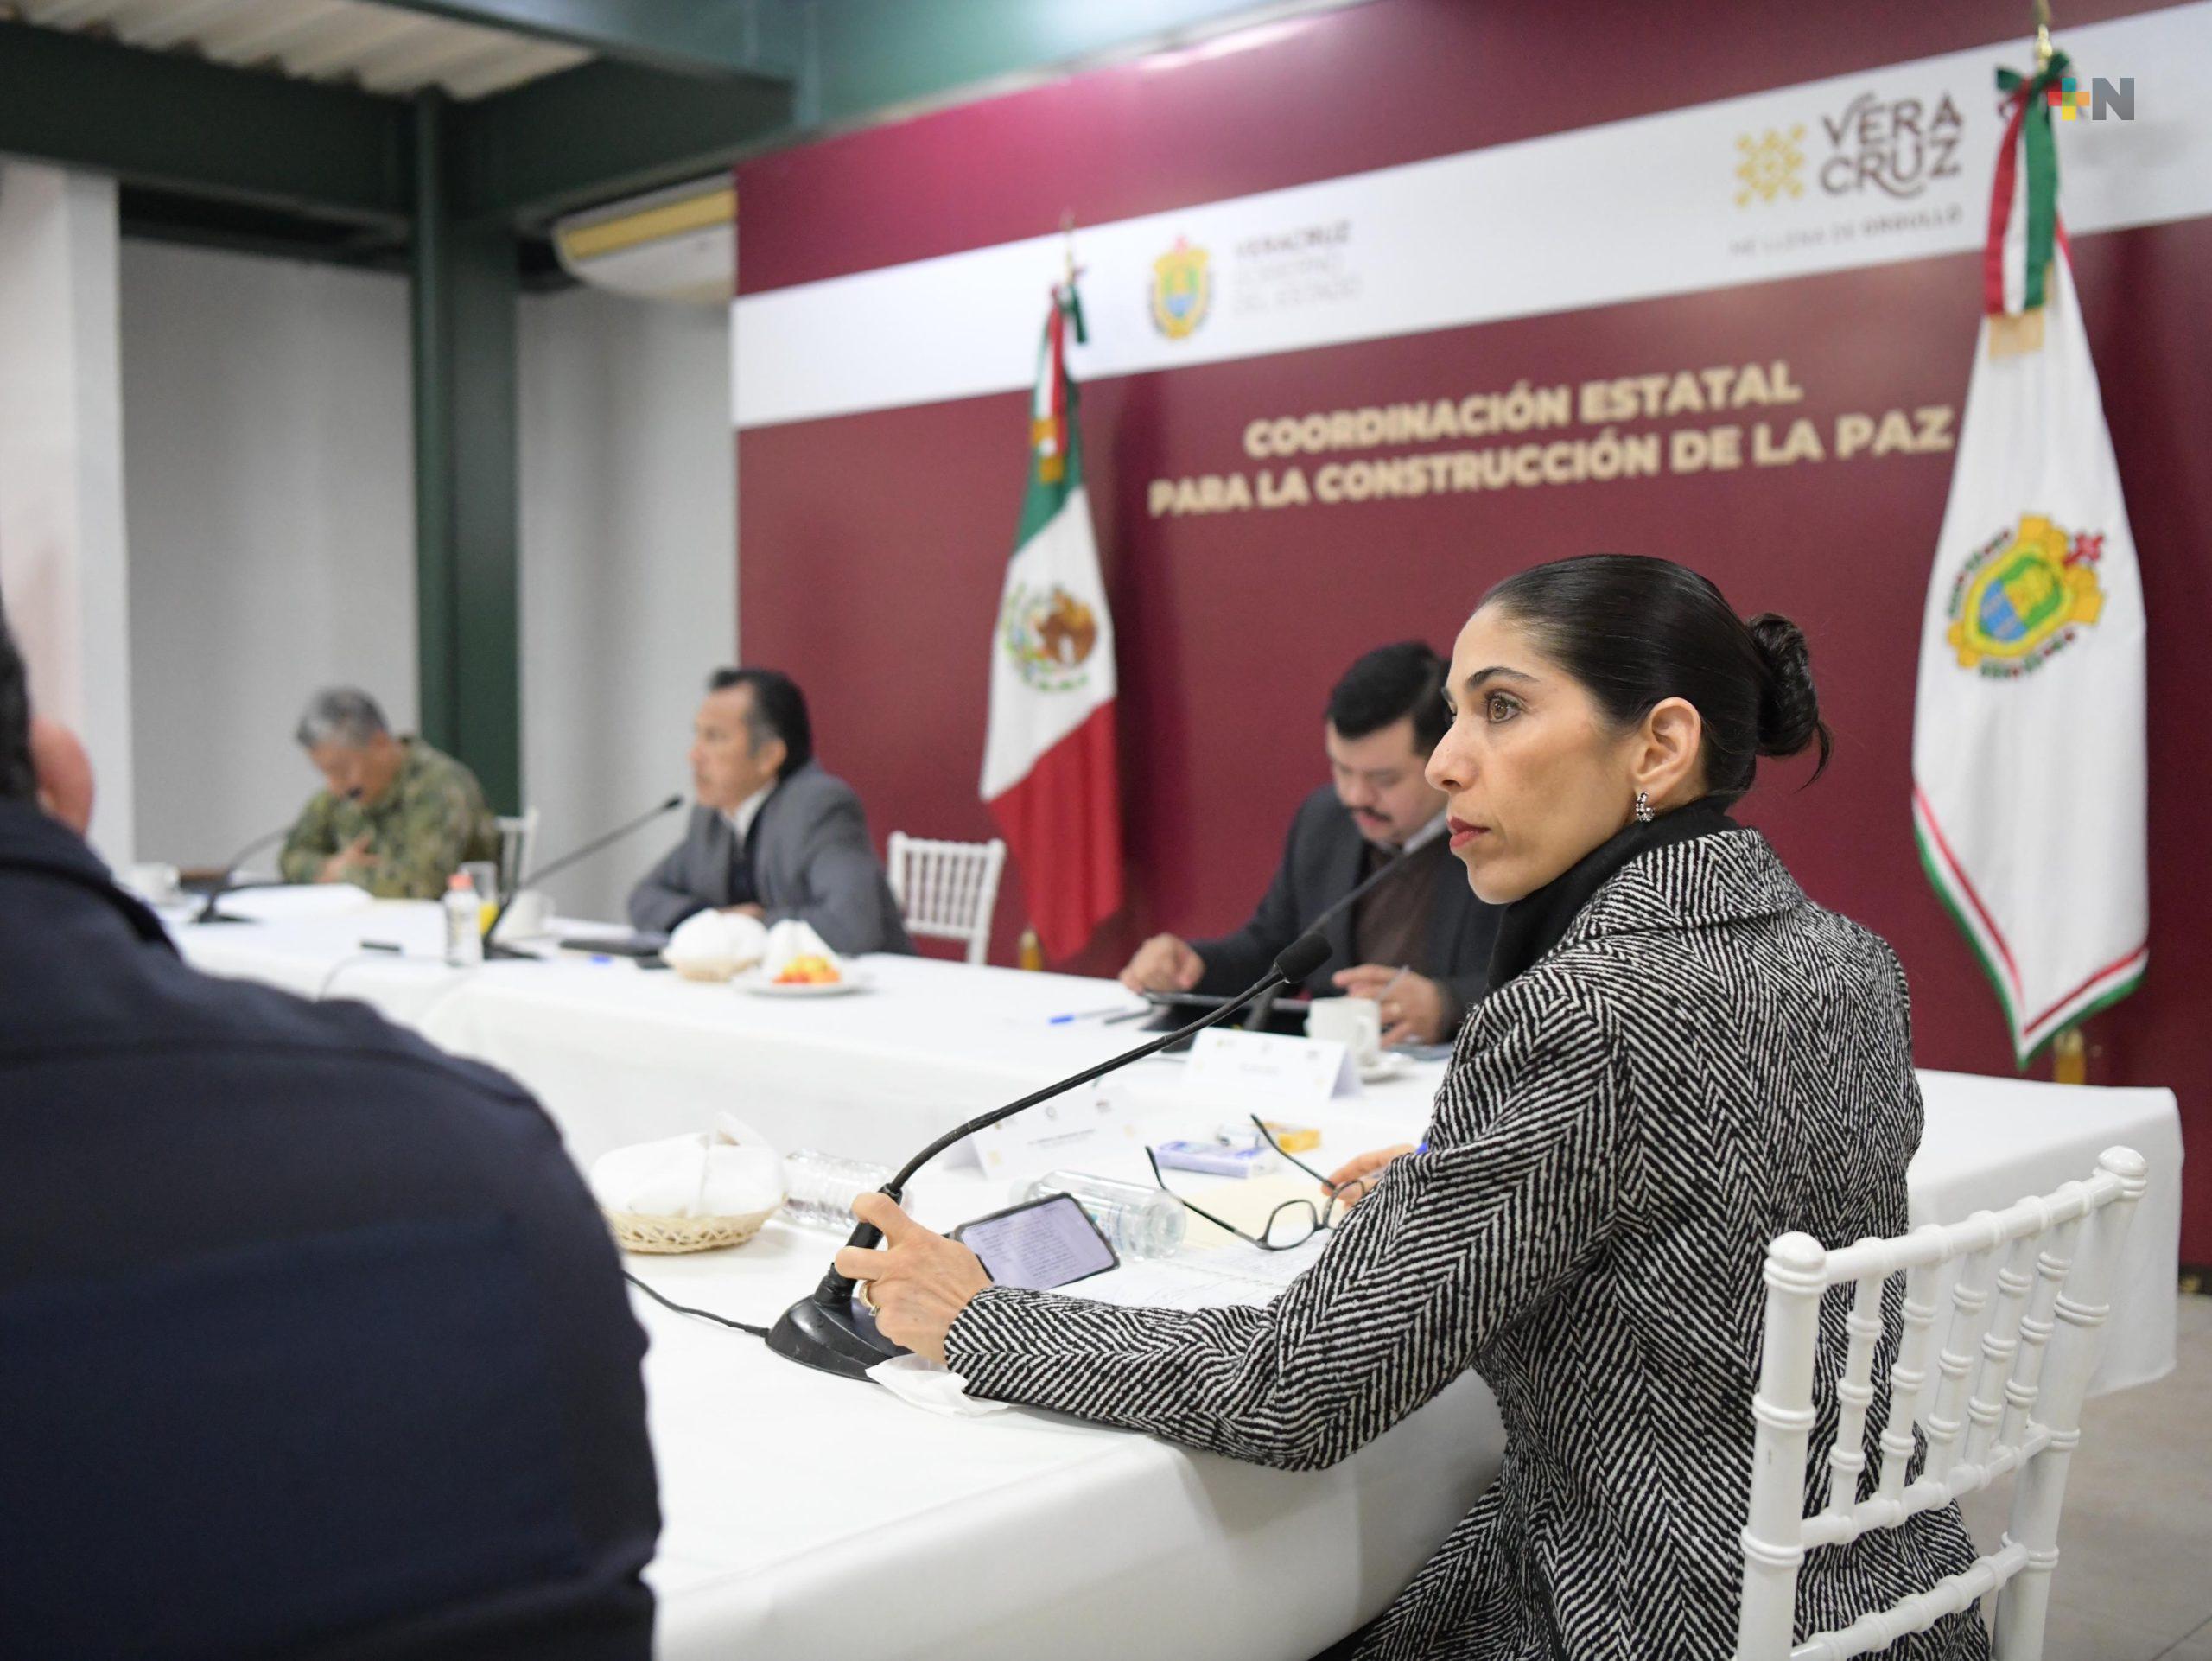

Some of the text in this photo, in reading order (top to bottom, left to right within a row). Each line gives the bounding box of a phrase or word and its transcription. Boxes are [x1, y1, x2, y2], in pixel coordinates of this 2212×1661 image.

[1821, 90, 1963, 146] VERA
[1819, 138, 1961, 200] CRUZ
[1243, 360, 1803, 458] COORDINACIÓN ESTATAL
[1148, 404, 1955, 516] PARA LA CONSTRUCCIÓN DE LA PAZ
